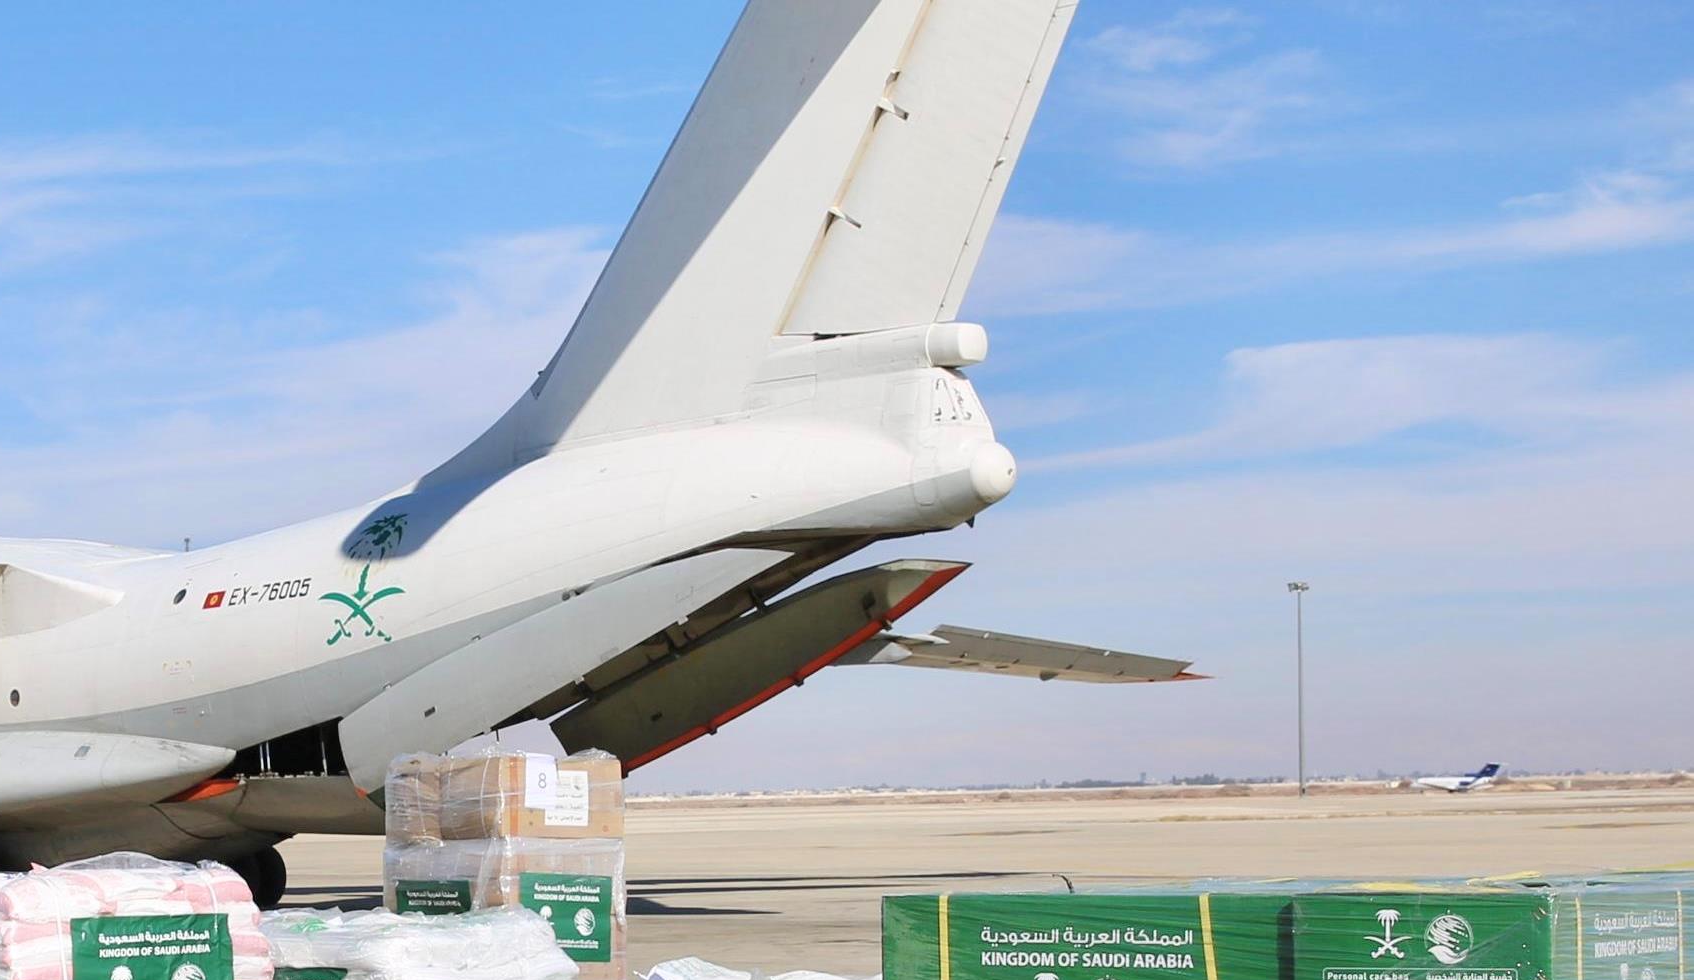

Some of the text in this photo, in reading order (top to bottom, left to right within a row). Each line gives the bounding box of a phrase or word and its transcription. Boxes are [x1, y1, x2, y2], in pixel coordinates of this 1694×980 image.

[228, 578, 311, 606] EX-76005
[538, 773, 546, 788] 8
[981, 927, 1193, 947] المملكة العربية السعودية
[100, 944, 210, 957] KINGDOM OF SAUDI ARABIA
[982, 952, 1193, 968] KINGDOM OF SAUDI ARABIA
